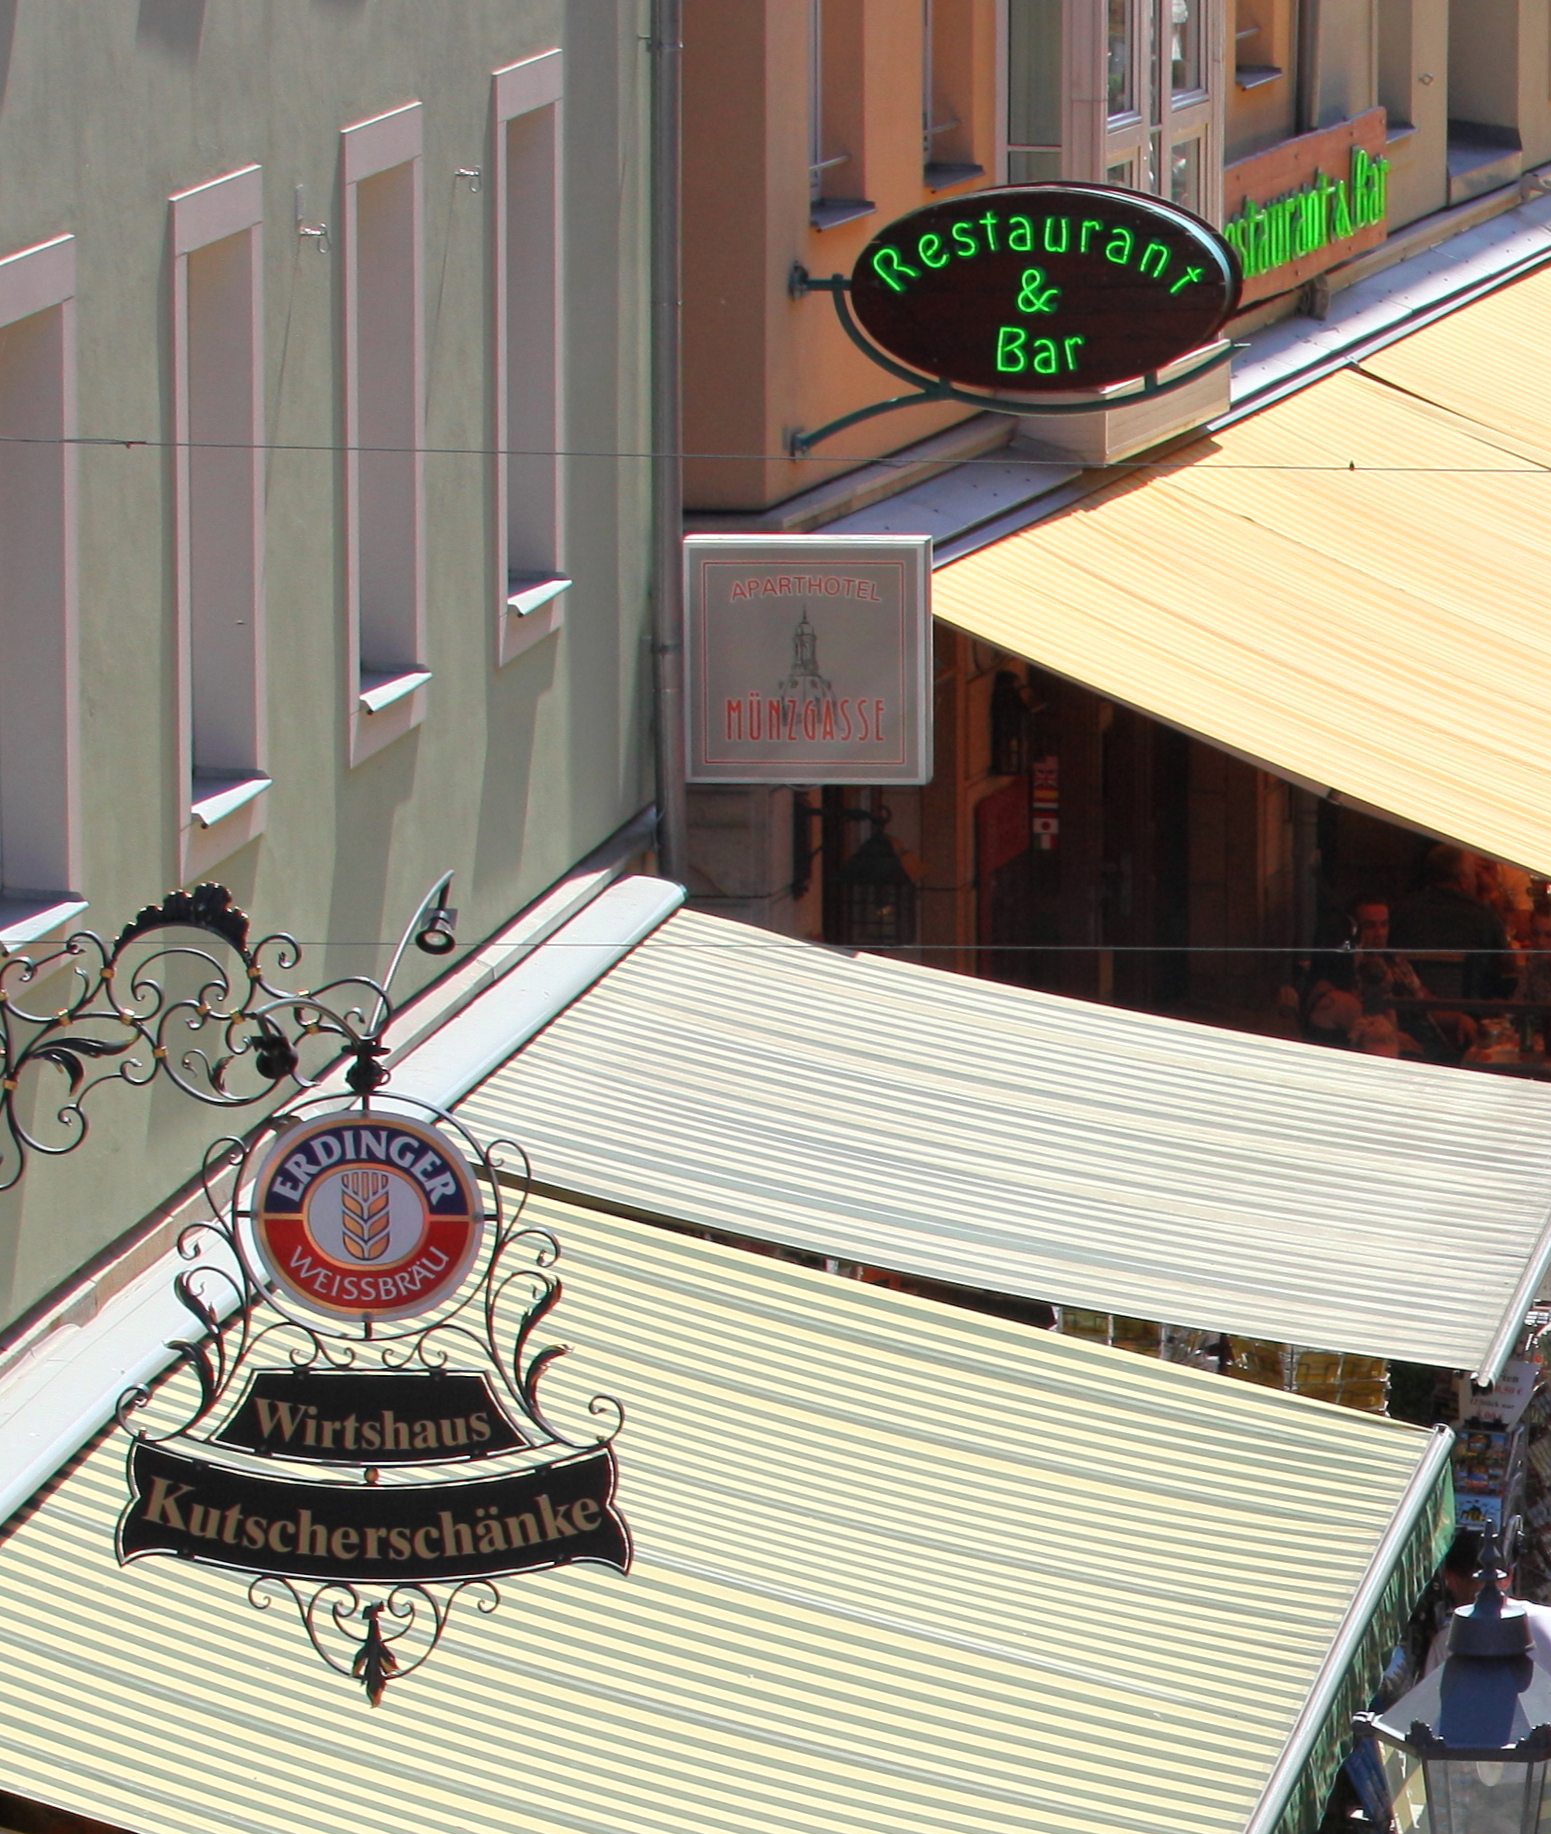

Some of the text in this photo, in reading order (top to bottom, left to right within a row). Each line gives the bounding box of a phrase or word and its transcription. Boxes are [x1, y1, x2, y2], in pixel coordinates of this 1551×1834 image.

[870, 212, 1205, 296] Restaurant
[1015, 268, 1061, 315] &
[995, 325, 1086, 375] Bar
[730, 575, 882, 602] APARTHOTEL
[726, 691, 885, 742] MÜNZGASSE
[271, 1129, 458, 1204] ERDINGER
[289, 1244, 450, 1301] WEISSBRÄU
[253, 1396, 493, 1451] Wirtshaus
[142, 1475, 604, 1561] Kutscherschänke
